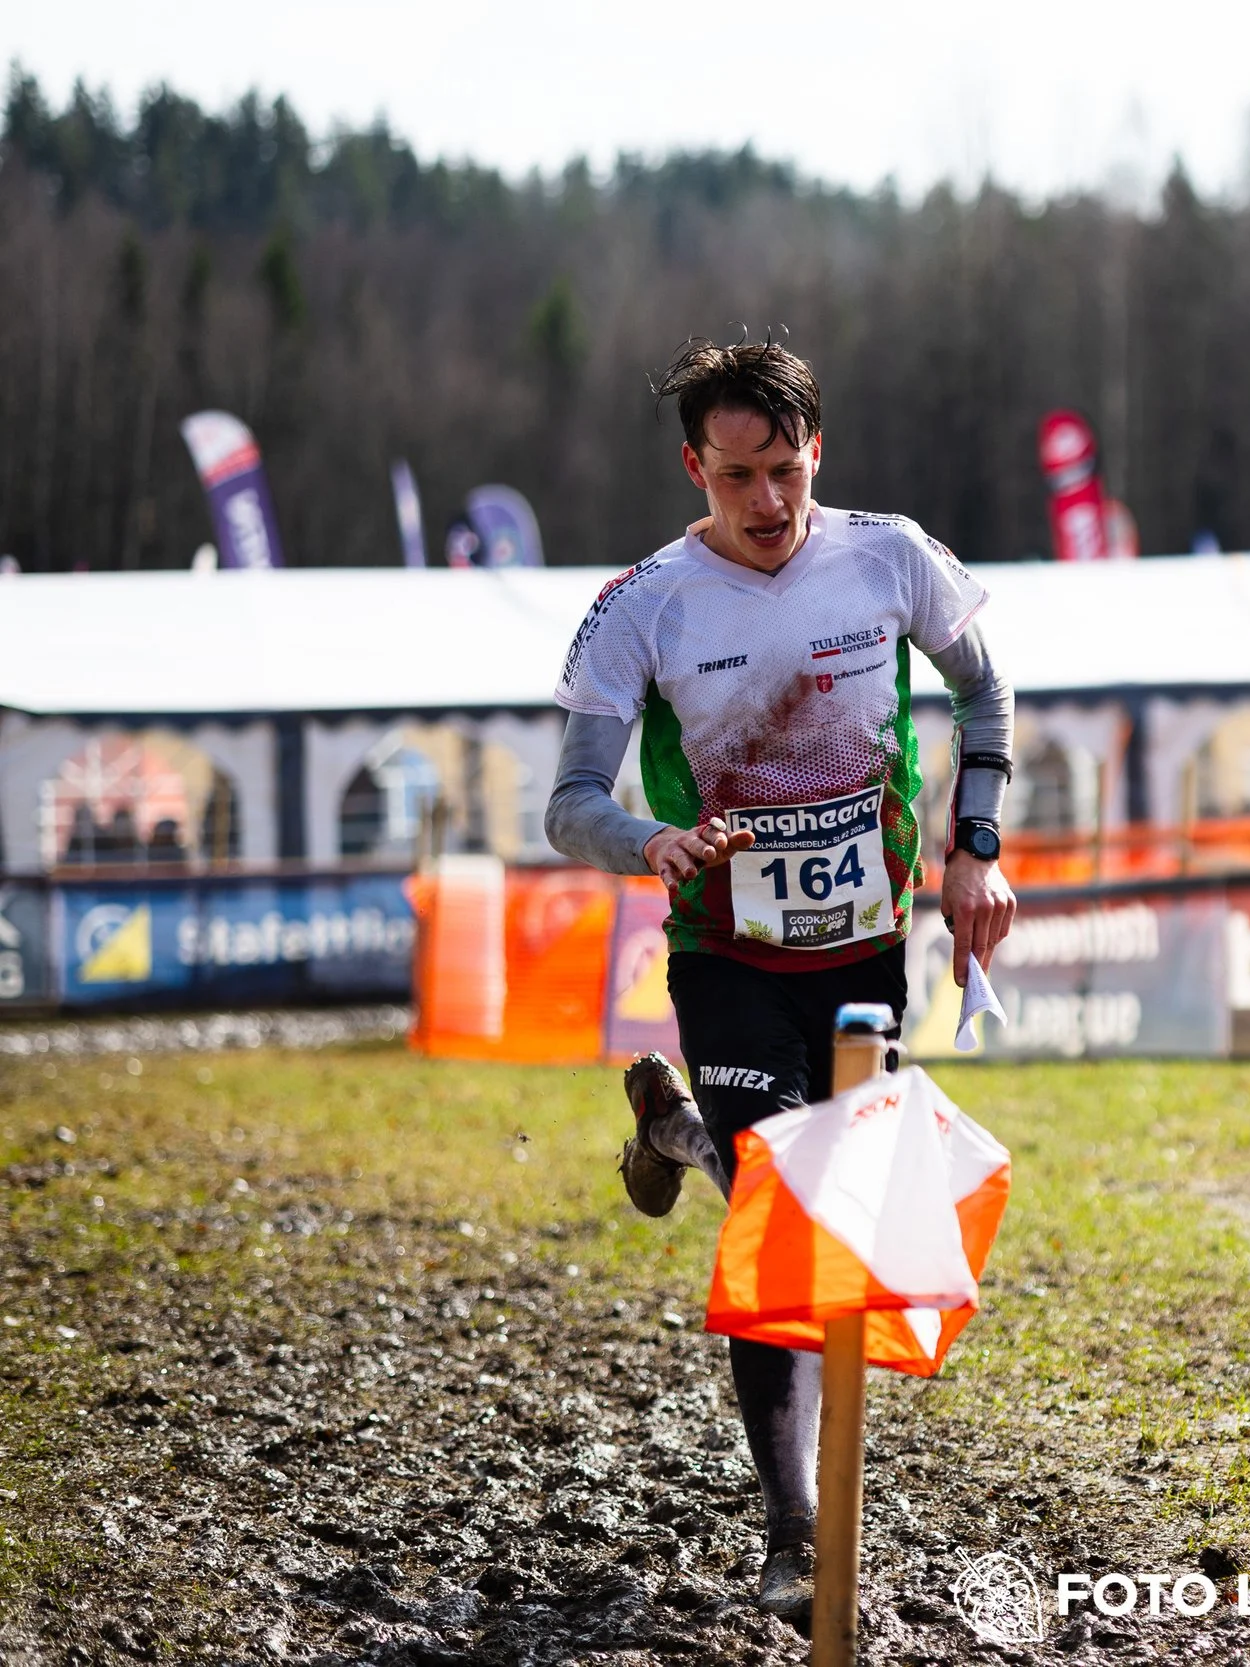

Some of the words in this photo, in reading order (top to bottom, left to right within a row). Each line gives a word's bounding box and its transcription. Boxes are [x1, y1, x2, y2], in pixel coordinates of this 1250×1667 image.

[601, 589, 625, 615] BIKE
[629, 563, 662, 586] RACE
[809, 629, 872, 652] TULLINGE
[873, 625, 885, 638] SK
[841, 639, 879, 654] BOTKYRKA
[697, 653, 749, 675] TRIMTEX
[833, 668, 865, 681] BOTKYRKA
[731, 794, 879, 837] bagheera
[850, 824, 866, 836] 2026
[760, 843, 866, 901] 164
[789, 910, 848, 925] GODKÄNDA
[789, 917, 847, 938] AVLOPP
[699, 1065, 776, 1092] TRIMTEX
